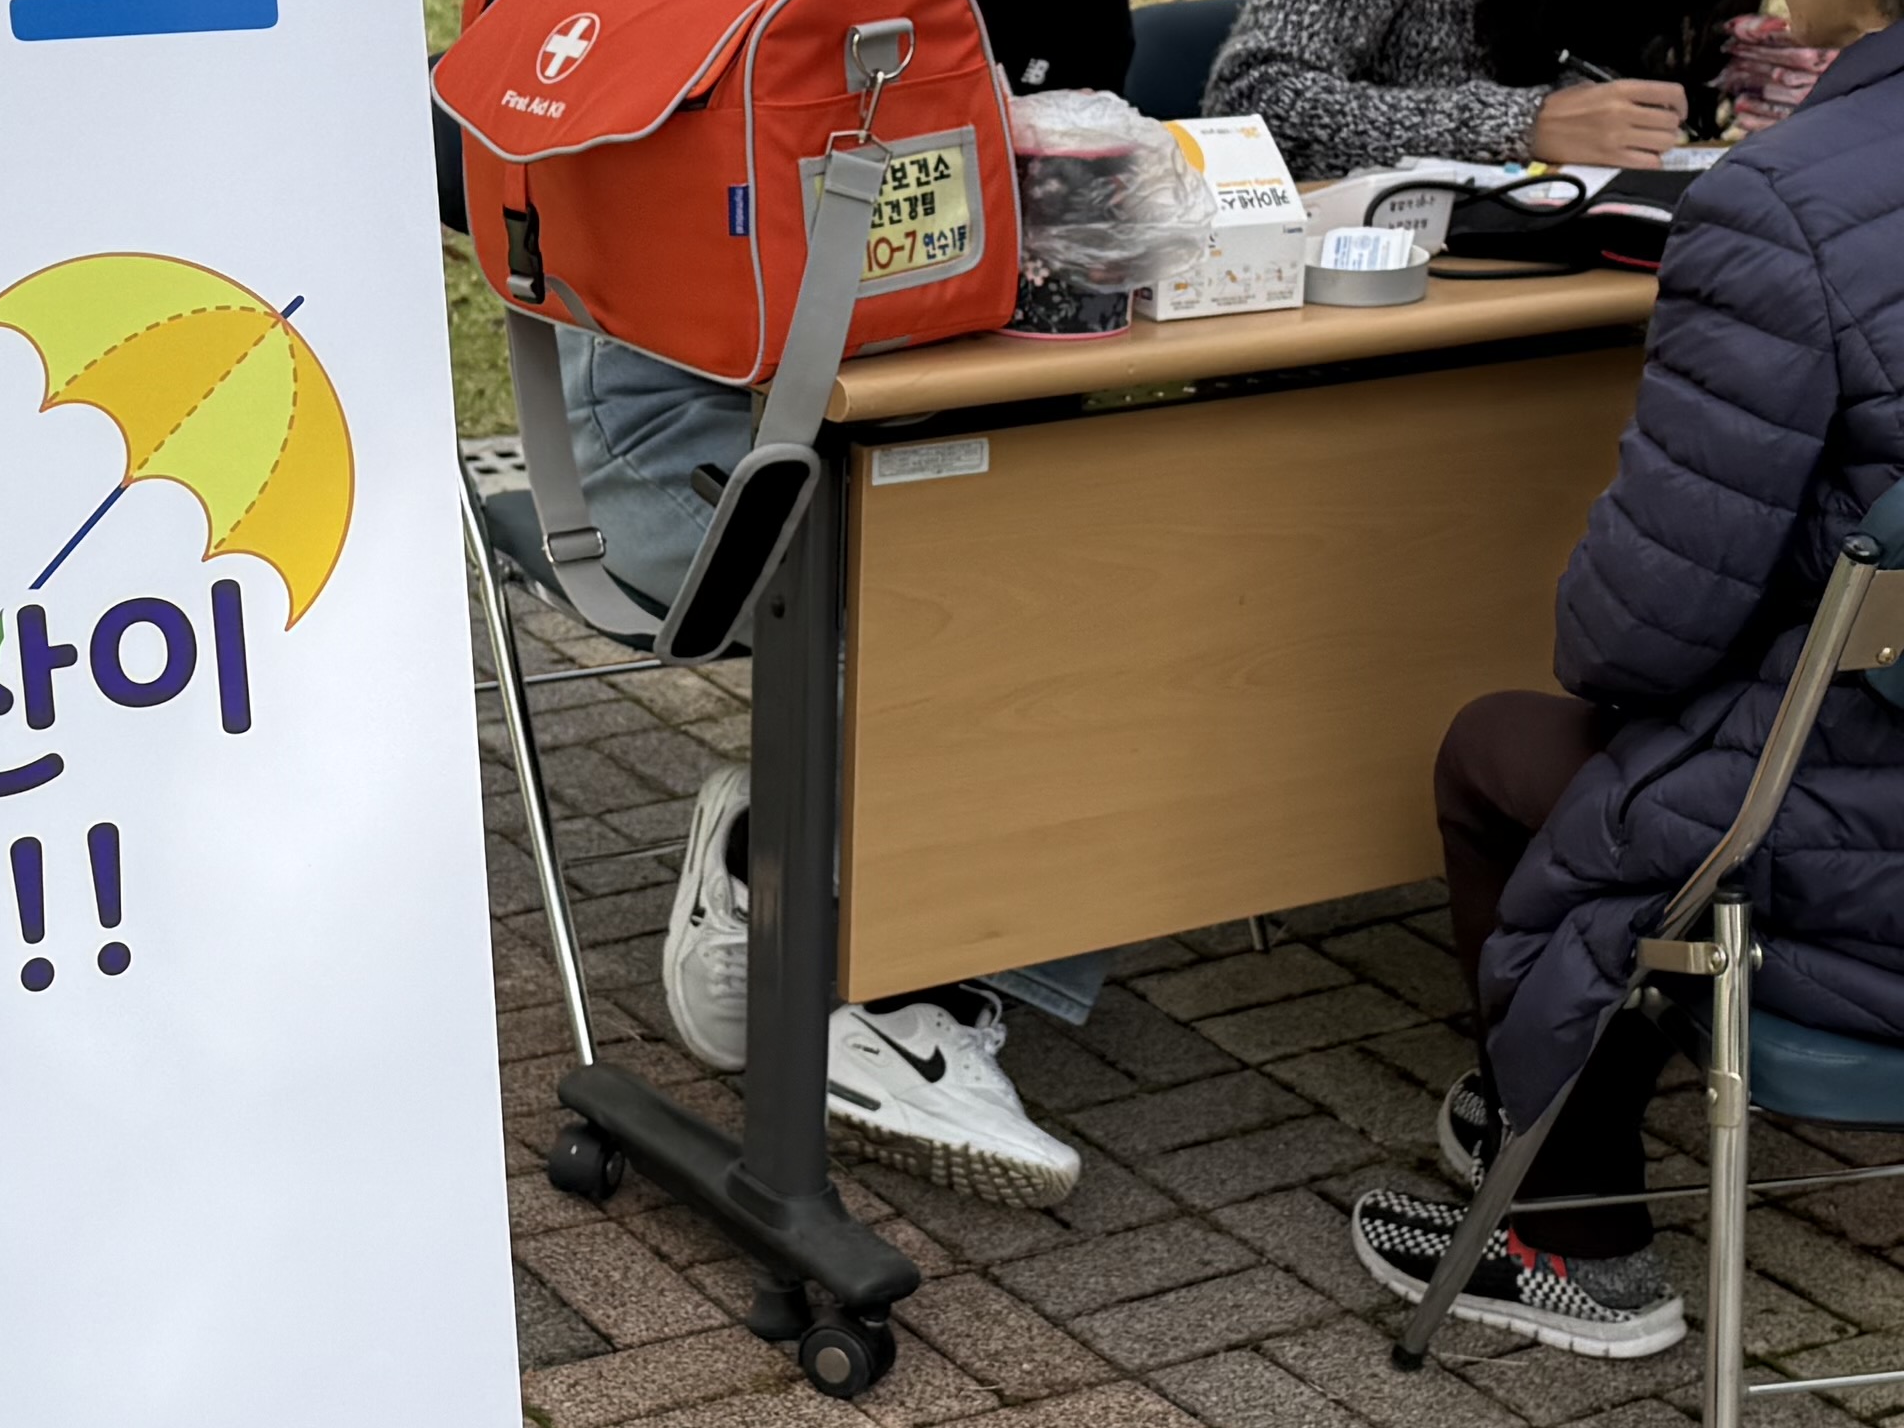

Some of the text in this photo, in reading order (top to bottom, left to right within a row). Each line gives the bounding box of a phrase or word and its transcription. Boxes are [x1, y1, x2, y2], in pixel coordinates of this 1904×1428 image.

[501, 89, 530, 112] First
[527, 96, 551, 116] Aid
[880, 154, 951, 196] 보건소
